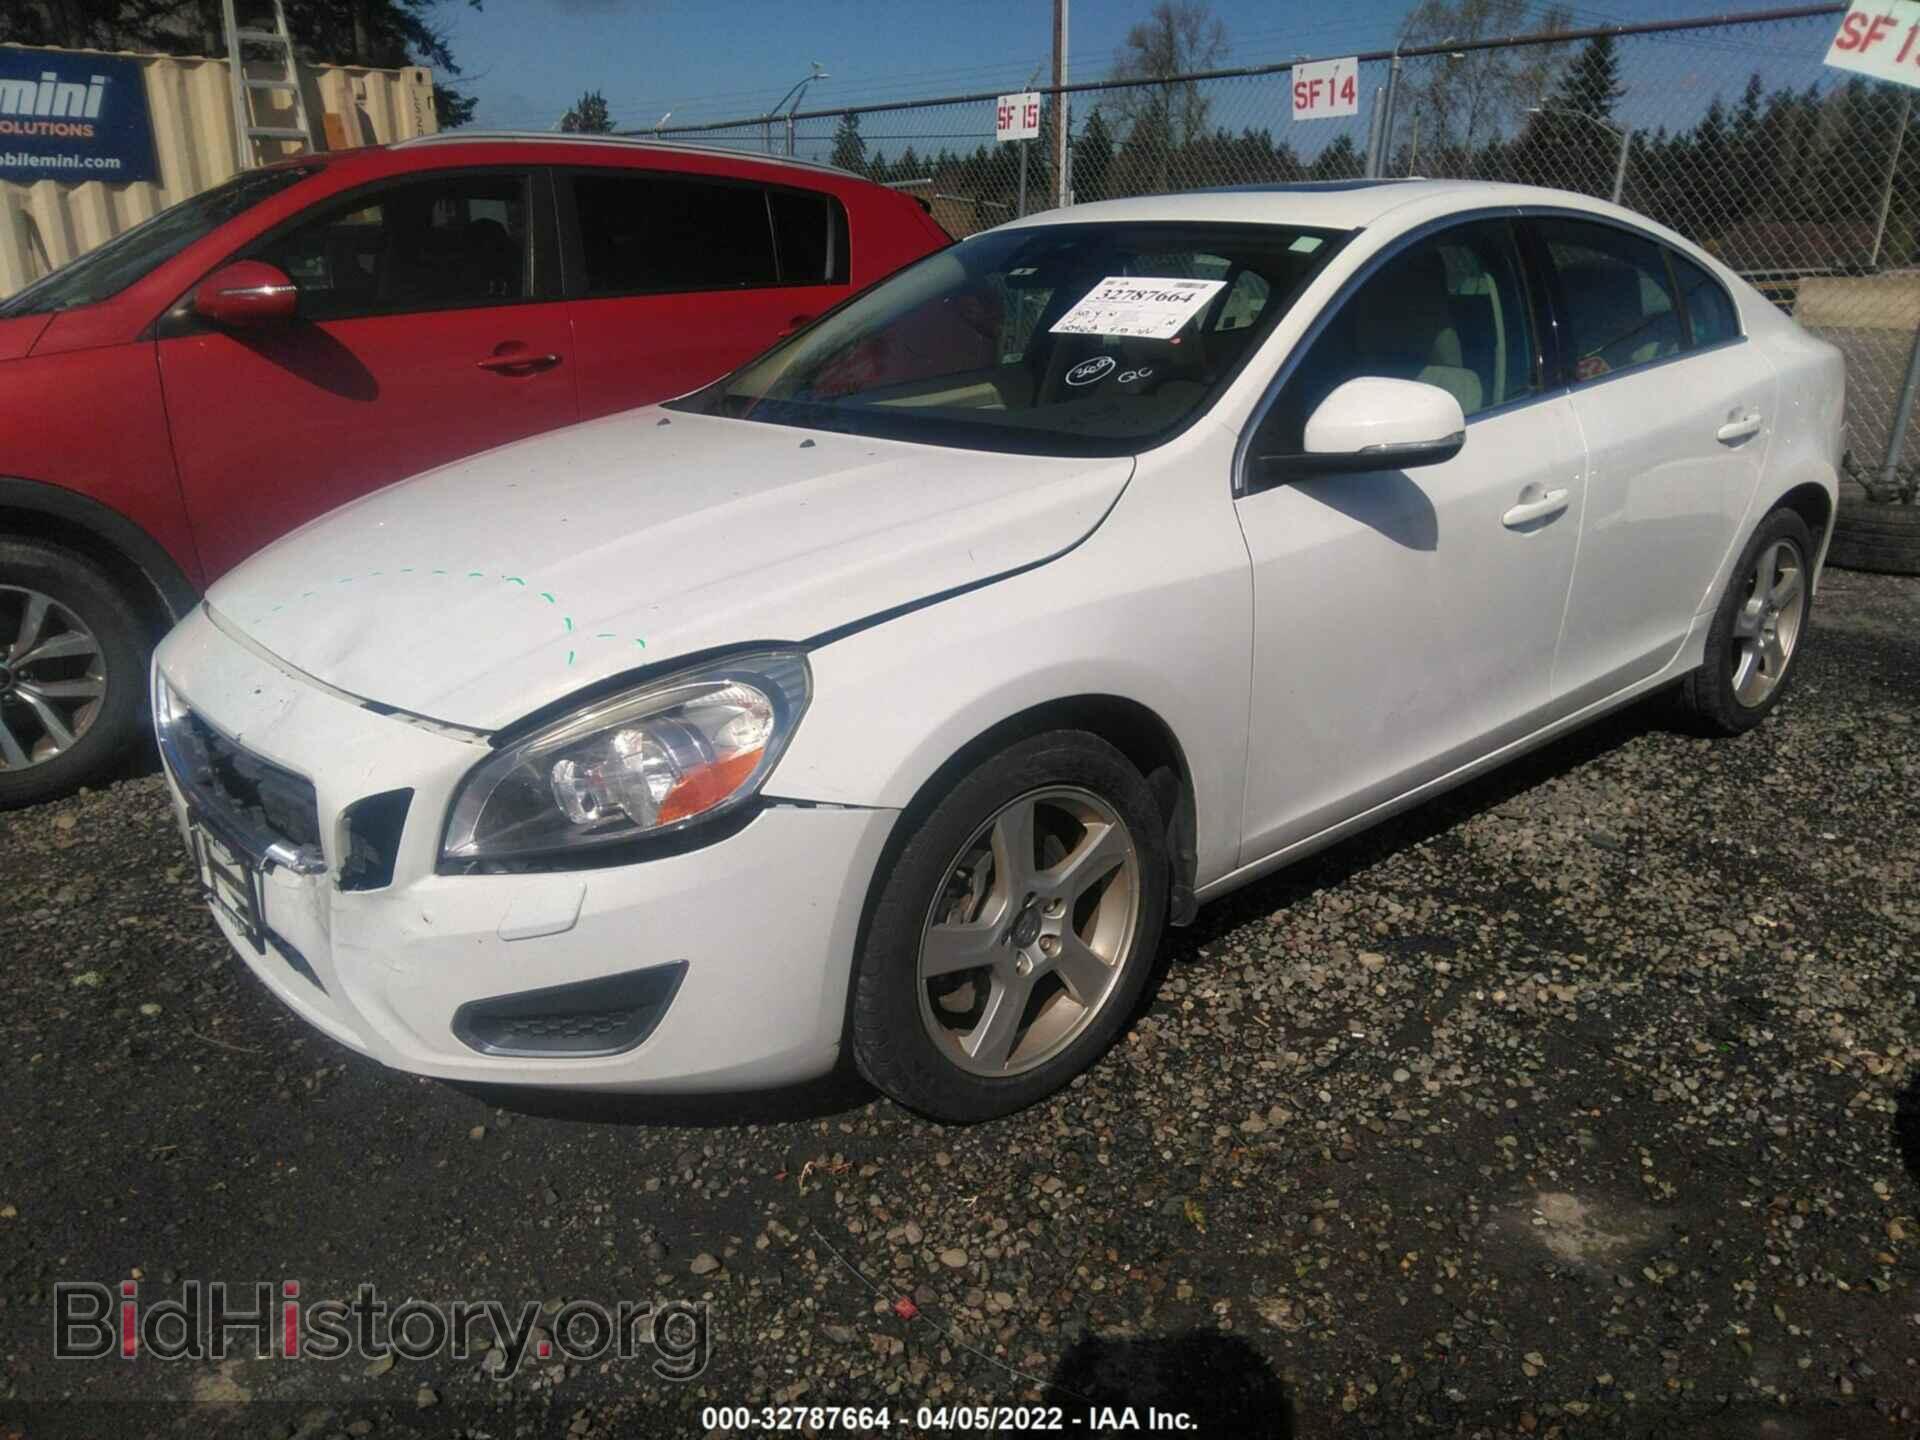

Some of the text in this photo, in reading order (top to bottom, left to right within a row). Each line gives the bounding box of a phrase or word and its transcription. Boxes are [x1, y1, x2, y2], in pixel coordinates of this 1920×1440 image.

[1836, 11, 1920, 67] SF 1
[0, 71, 105, 118] mini
[997, 103, 1037, 130] SF 15
[1096, 288, 1196, 303] 32787664
